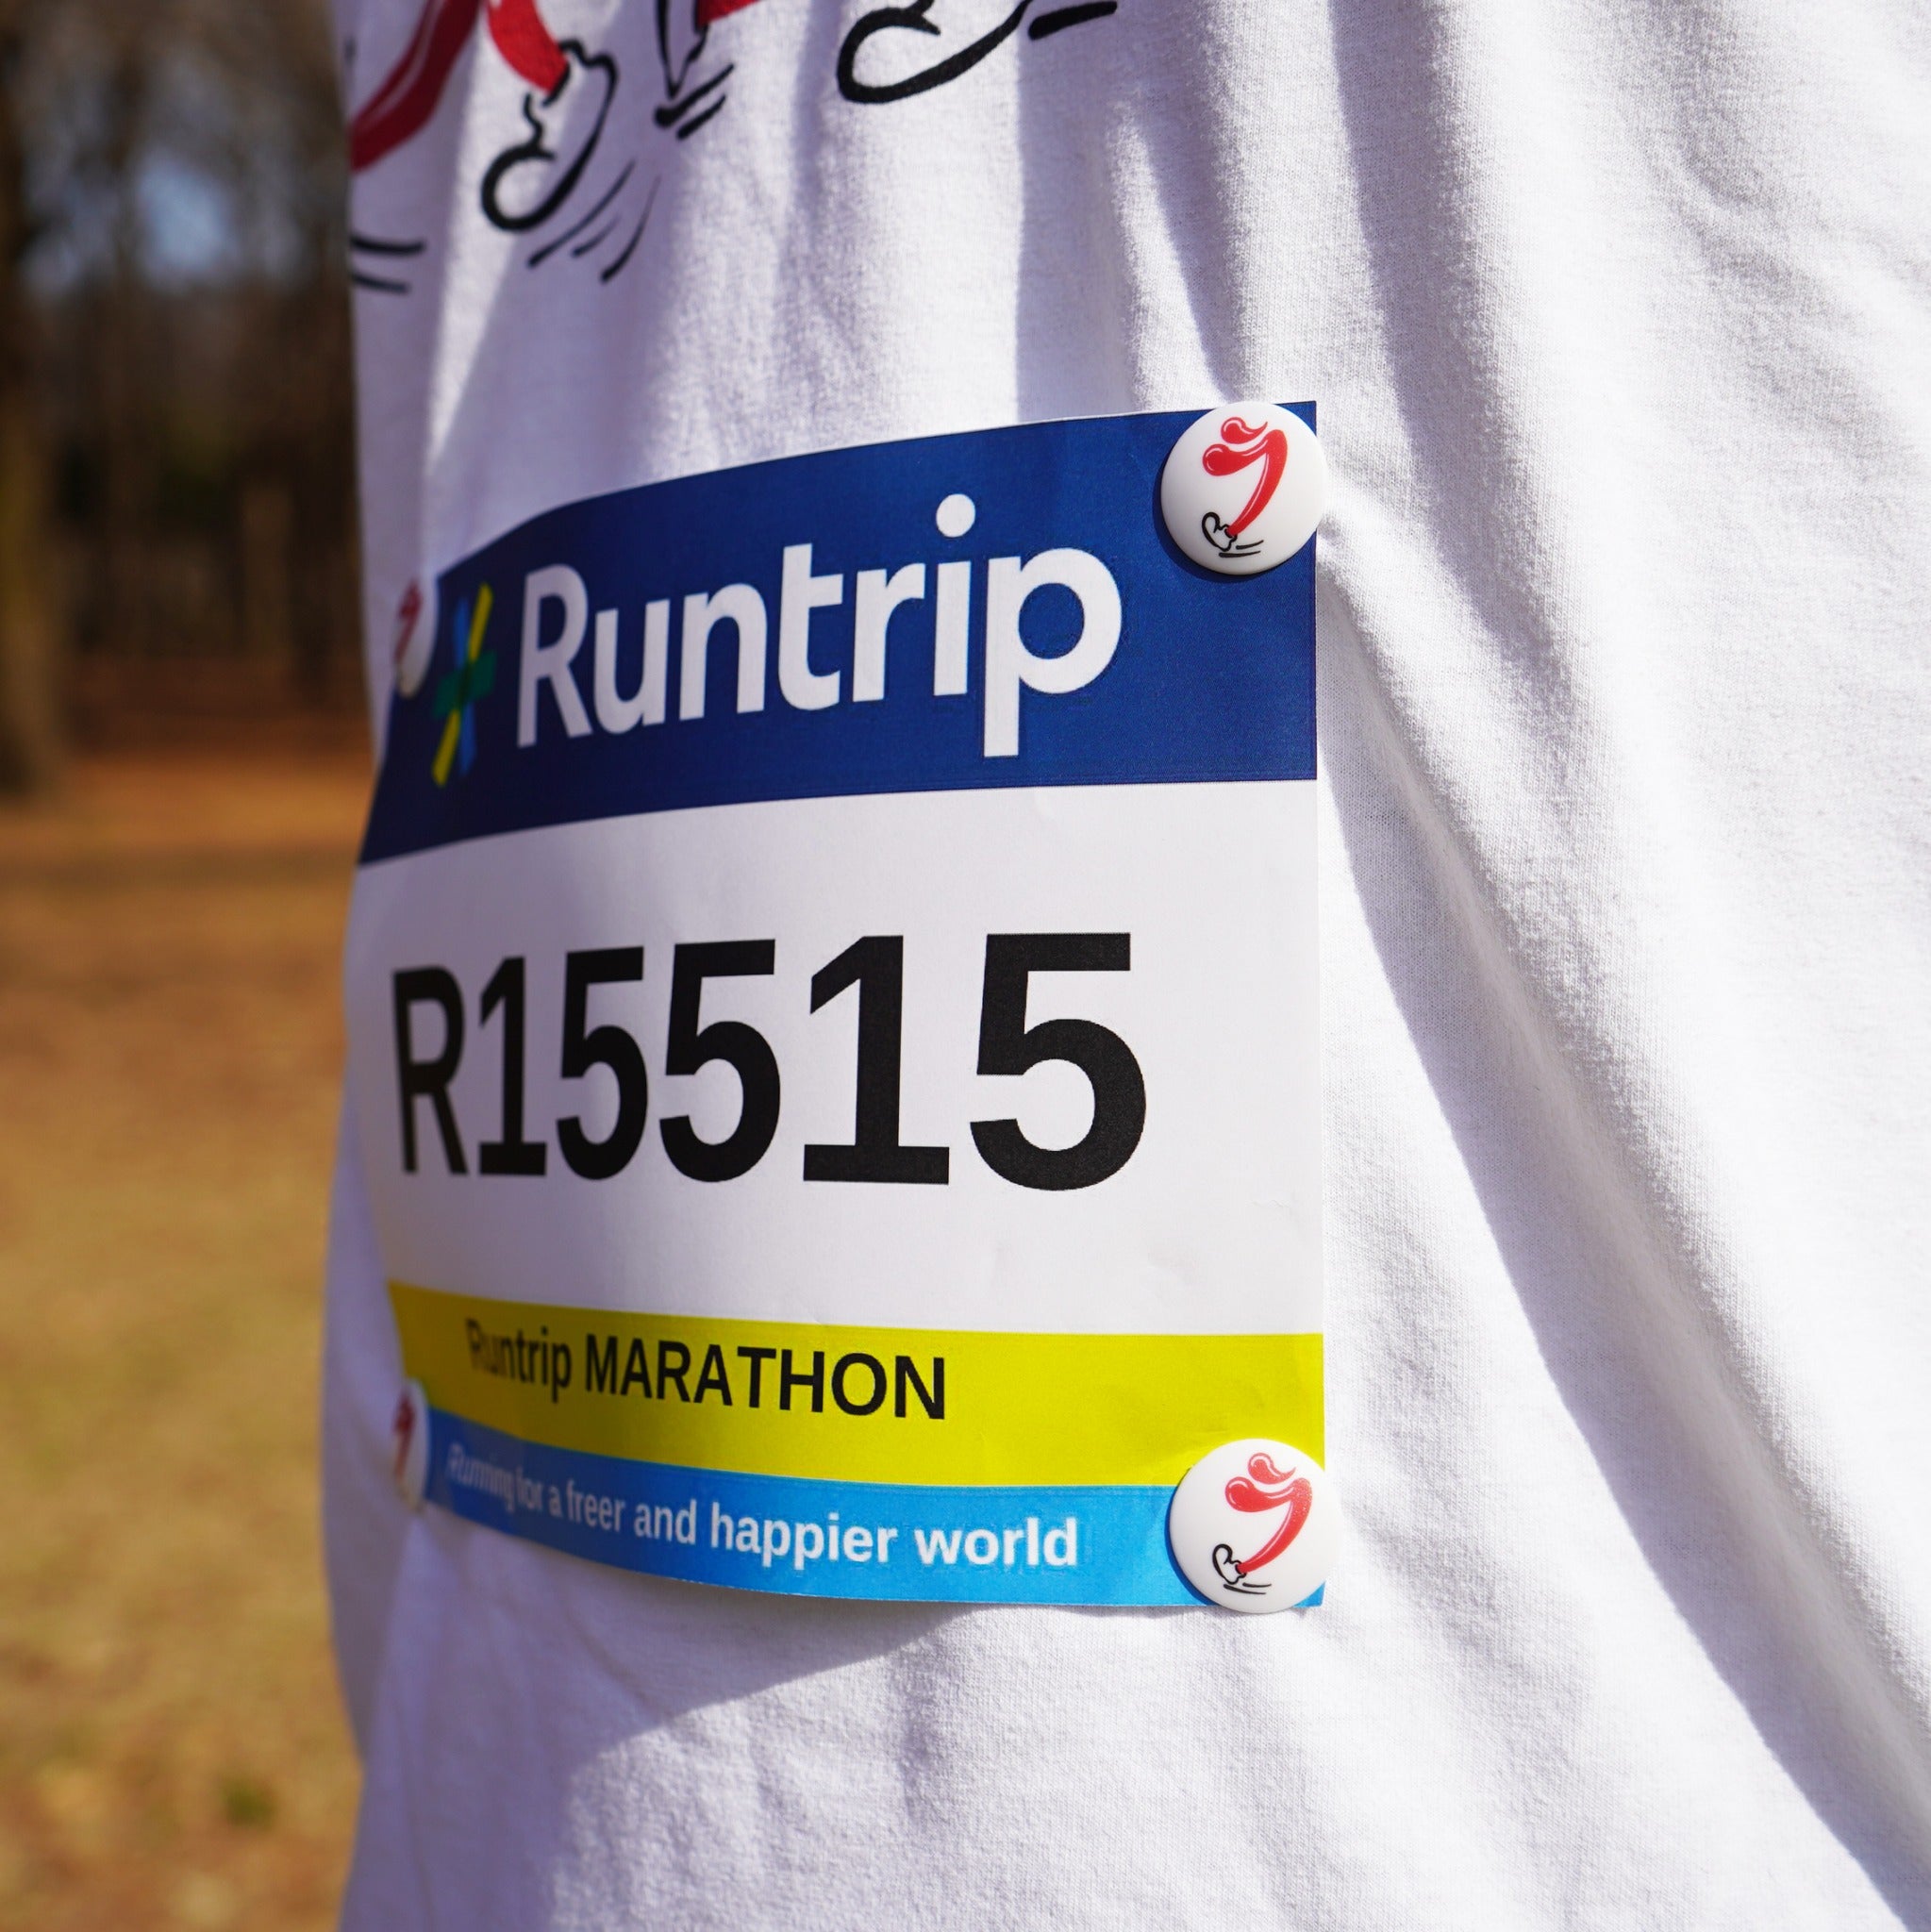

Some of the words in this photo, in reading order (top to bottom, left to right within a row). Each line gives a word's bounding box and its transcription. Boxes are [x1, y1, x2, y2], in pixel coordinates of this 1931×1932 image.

[517, 493, 1123, 758] Runtrip
[392, 932, 1147, 1192] R15515
[585, 1333, 946, 1421] MARATHON
[548, 1484, 563, 1518] a
[566, 1479, 626, 1533] freer
[633, 1498, 697, 1545] and
[710, 1502, 898, 1571] happier
[914, 1516, 1078, 1566] world
